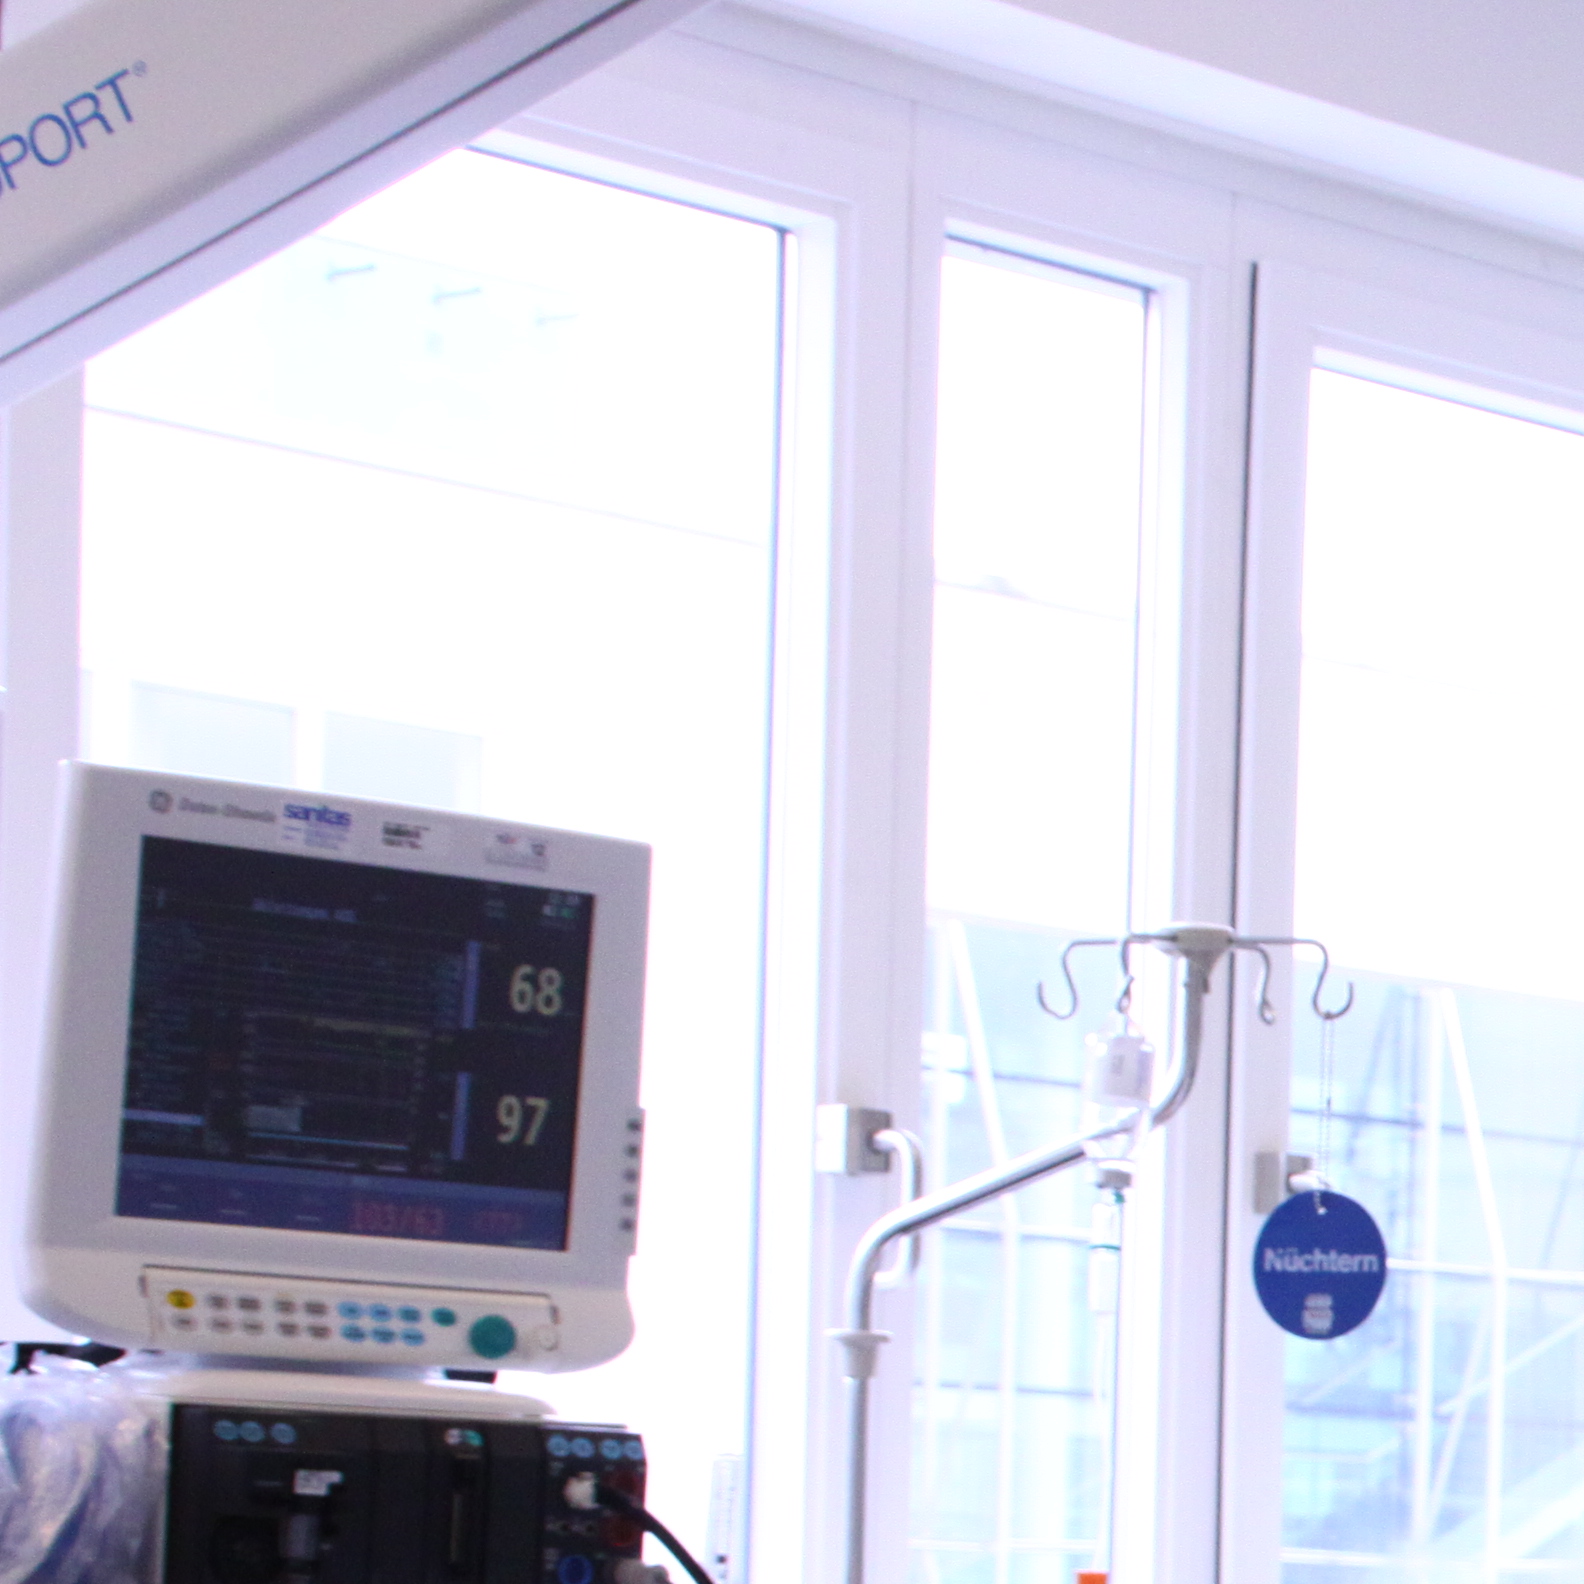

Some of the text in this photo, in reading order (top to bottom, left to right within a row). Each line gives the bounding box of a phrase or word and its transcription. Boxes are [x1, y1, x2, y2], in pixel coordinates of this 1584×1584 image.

[0, 68, 134, 194] PORT
[510, 964, 563, 1016] 68
[497, 1095, 549, 1145] 97
[1263, 1247, 1380, 1273] Nüchtern
